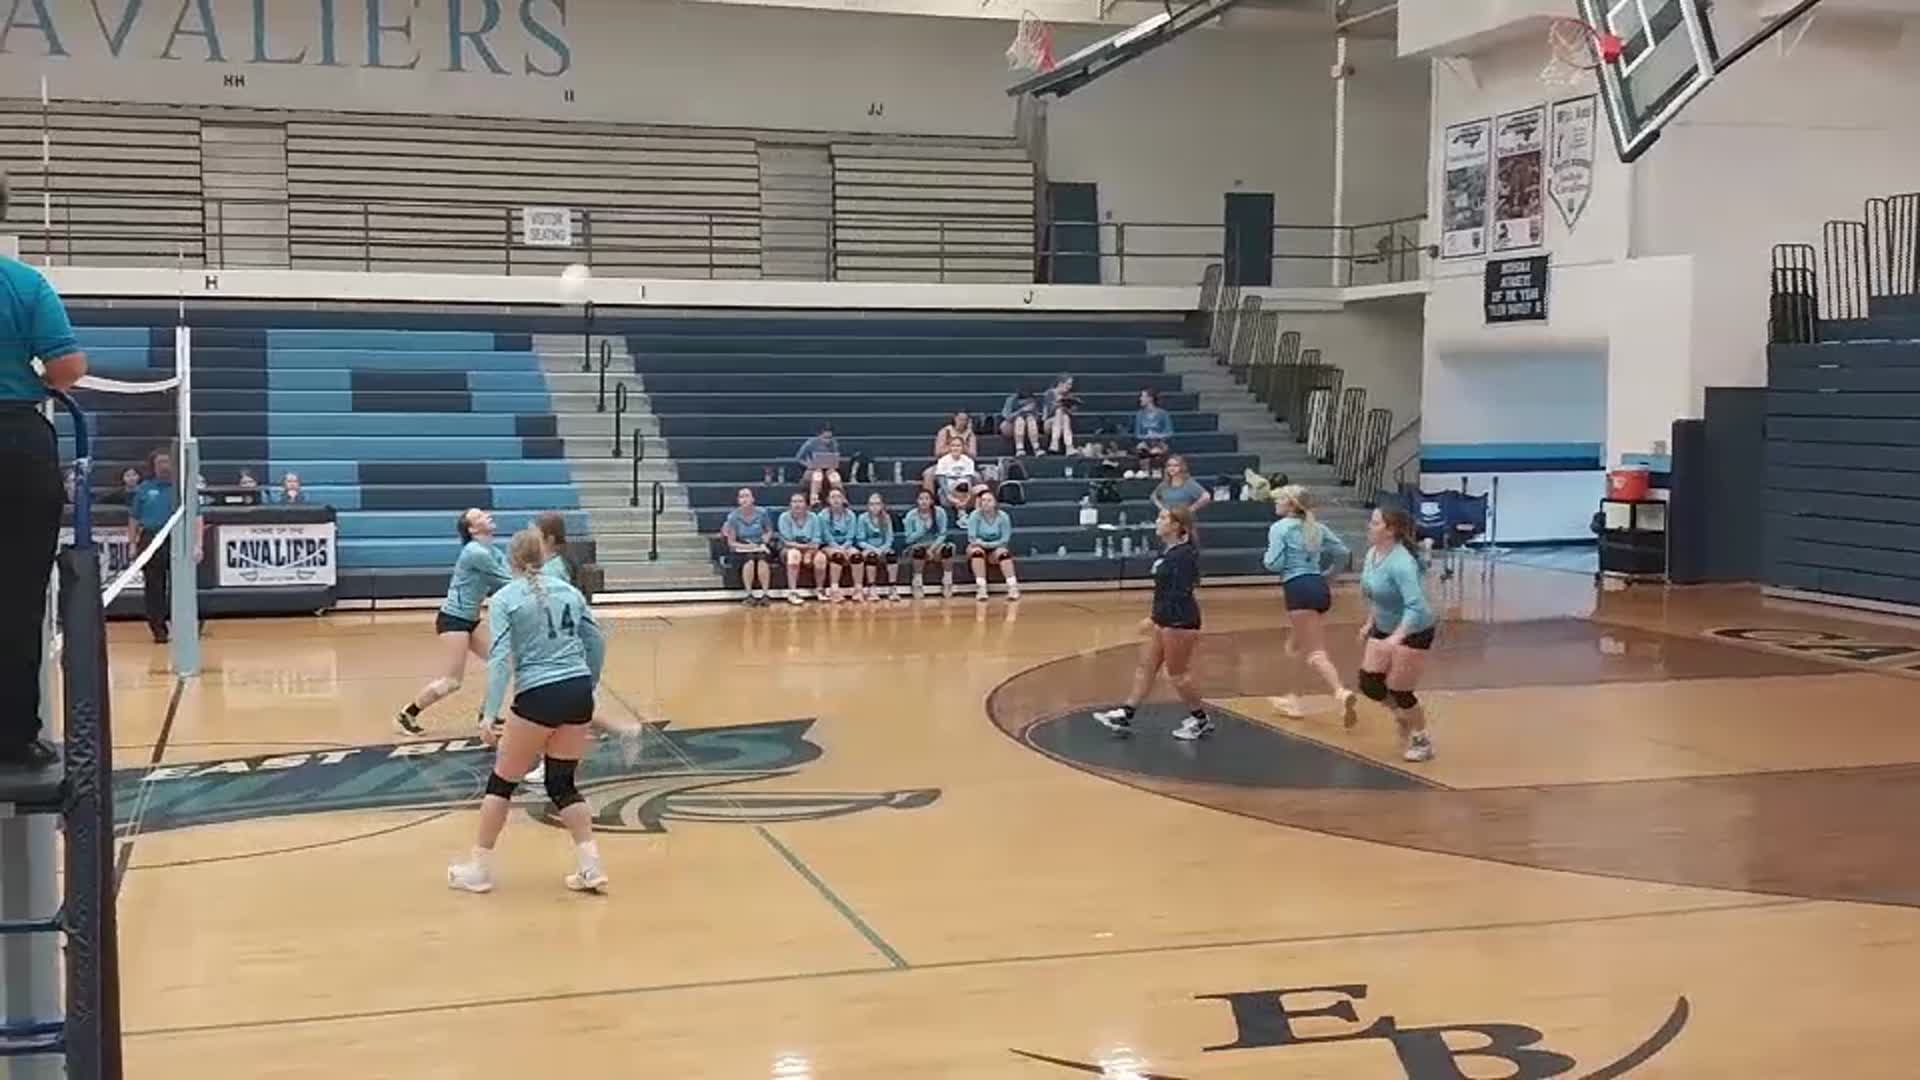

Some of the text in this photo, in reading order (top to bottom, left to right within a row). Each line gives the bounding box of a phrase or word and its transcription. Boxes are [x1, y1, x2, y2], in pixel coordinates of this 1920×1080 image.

[224, 74, 245, 88] HH
[867, 102, 883, 116] JJ
[531, 212, 562, 225] VISITOR
[529, 228, 566, 241] SEATING
[205, 275, 219, 290] H
[1023, 290, 1034, 304] J
[226, 538, 327, 569] CAVALIERS
[545, 603, 576, 640] 14
